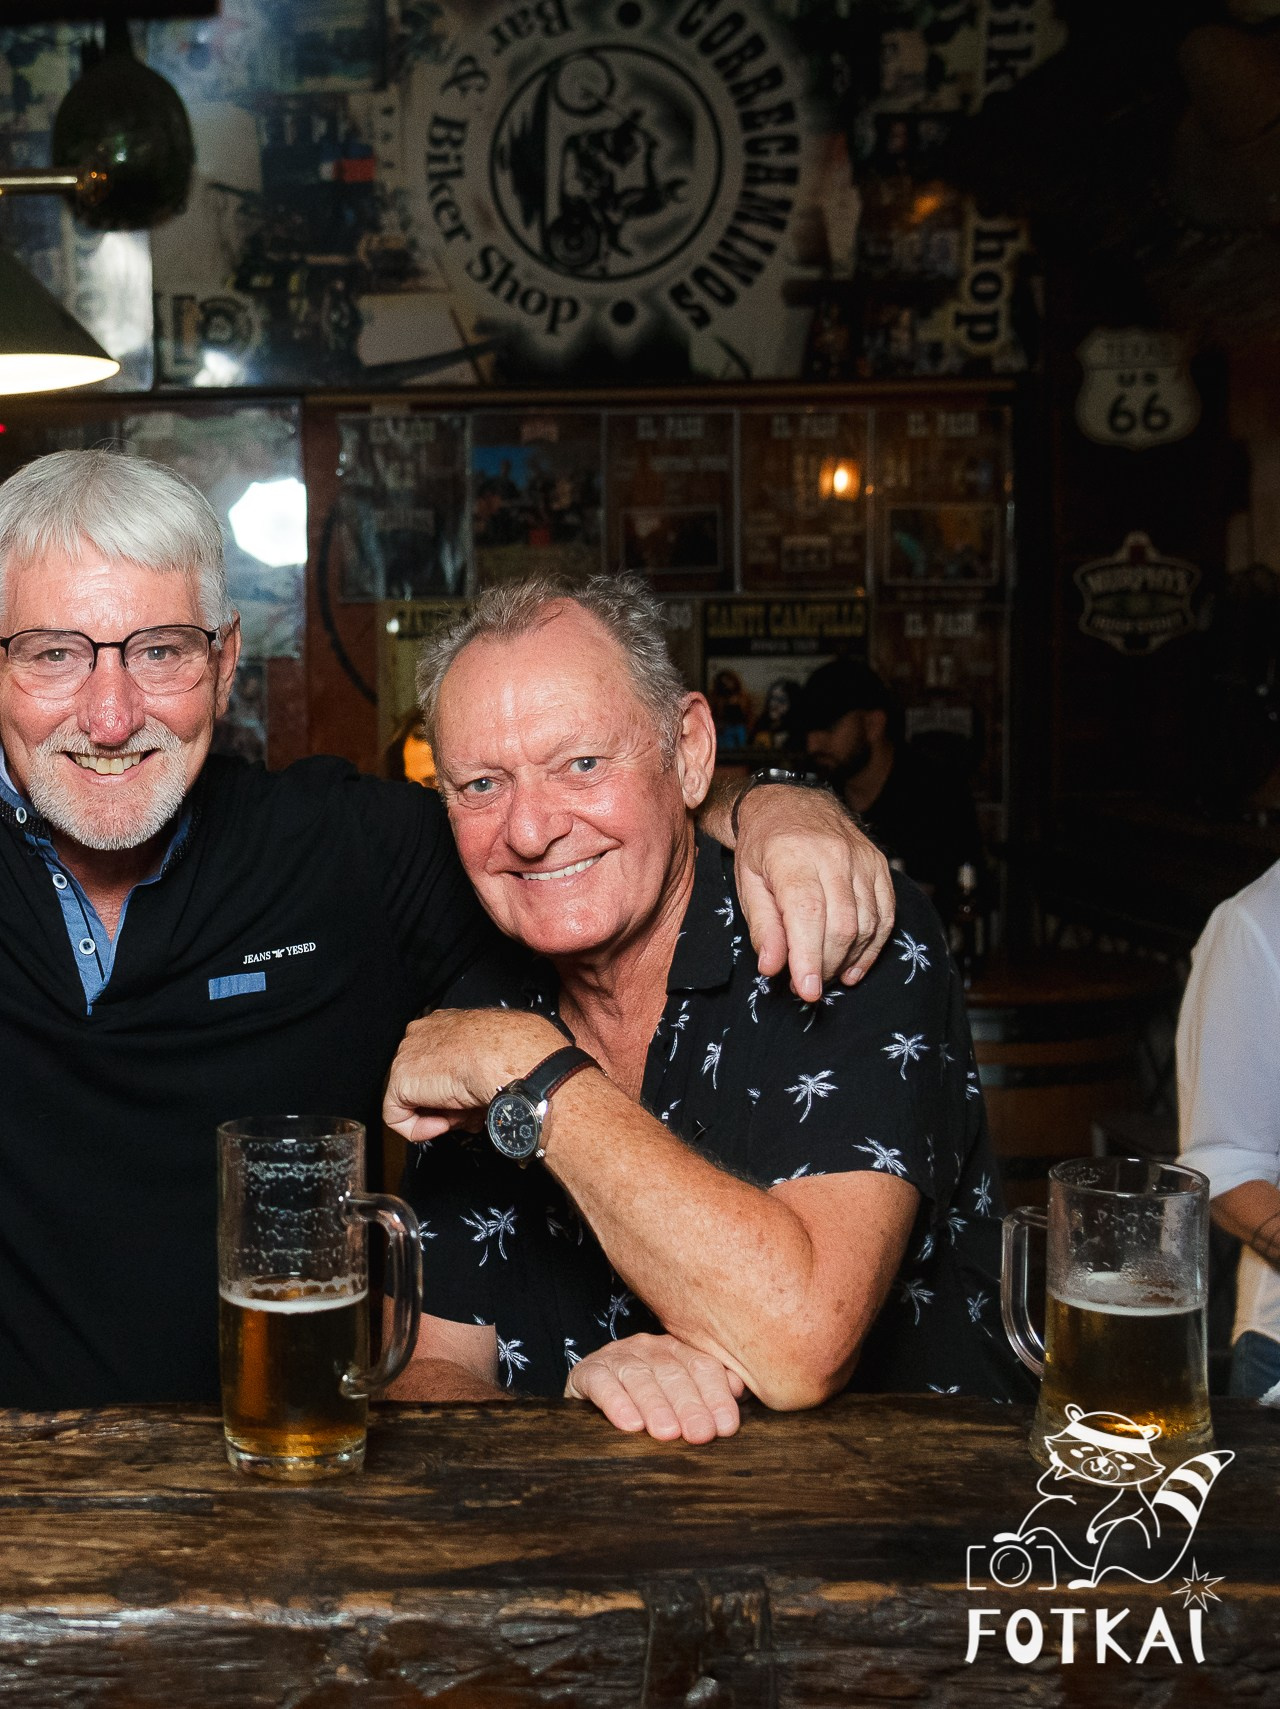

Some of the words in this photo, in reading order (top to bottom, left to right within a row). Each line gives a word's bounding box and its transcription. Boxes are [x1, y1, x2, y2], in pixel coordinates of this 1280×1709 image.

[489, 0, 570, 54] Bar
[426, 113, 471, 242] Biker
[669, 0, 800, 329] CORRECAMINOS
[466, 245, 579, 334] Shop
[1108, 391, 1172, 435] 66
[242, 951, 272, 965] JEANS
[285, 942, 317, 956] YESED
